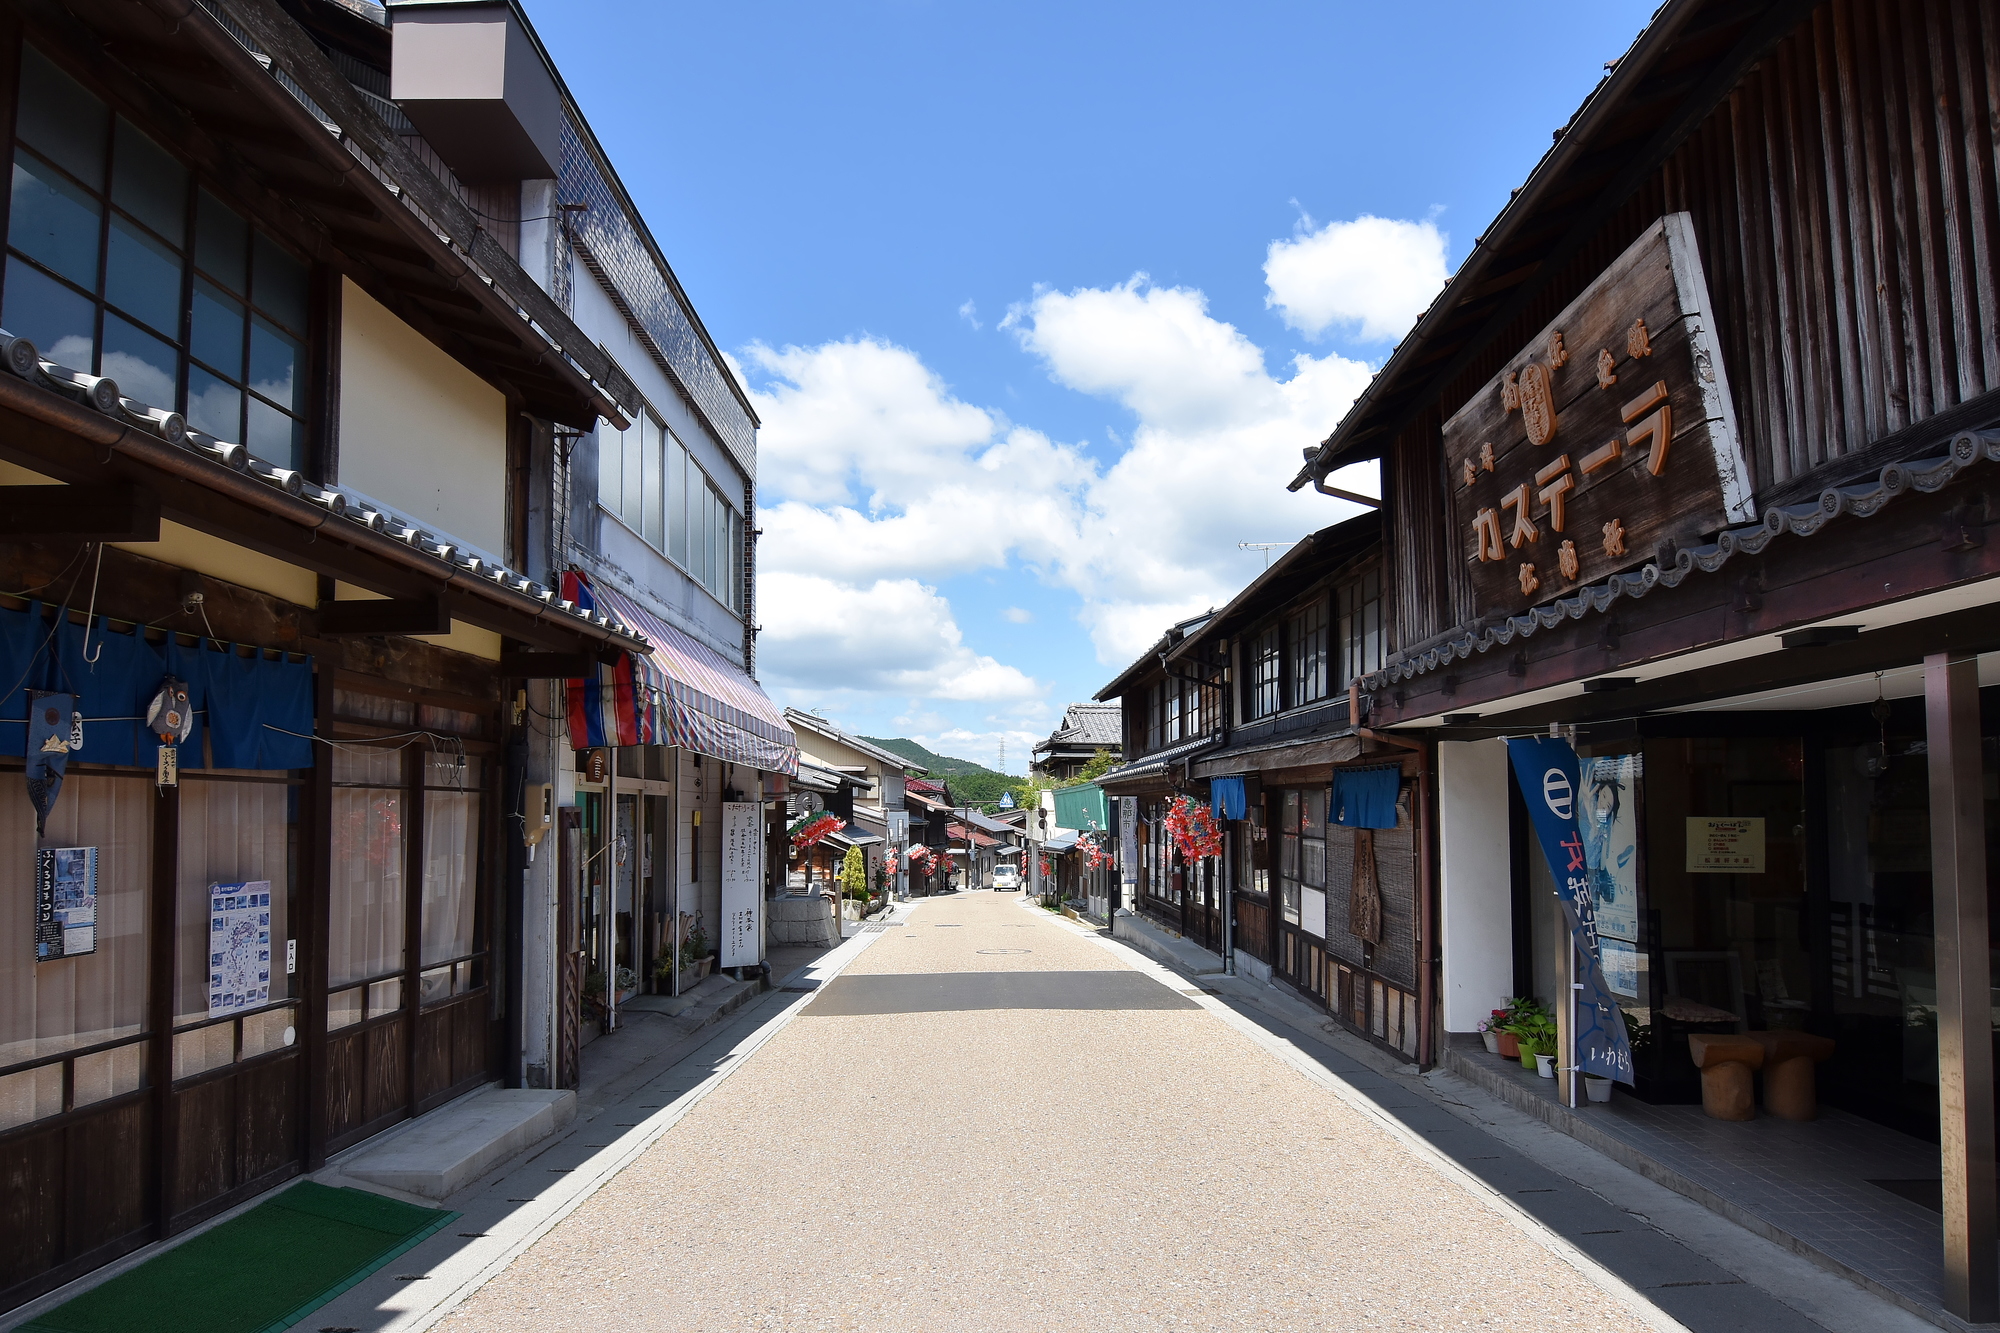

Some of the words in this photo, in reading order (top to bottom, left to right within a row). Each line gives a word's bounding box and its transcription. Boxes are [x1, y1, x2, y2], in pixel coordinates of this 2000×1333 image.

[1471, 379, 1671, 563] カステーラ
[1590, 1046, 1631, 1073] いわむら
